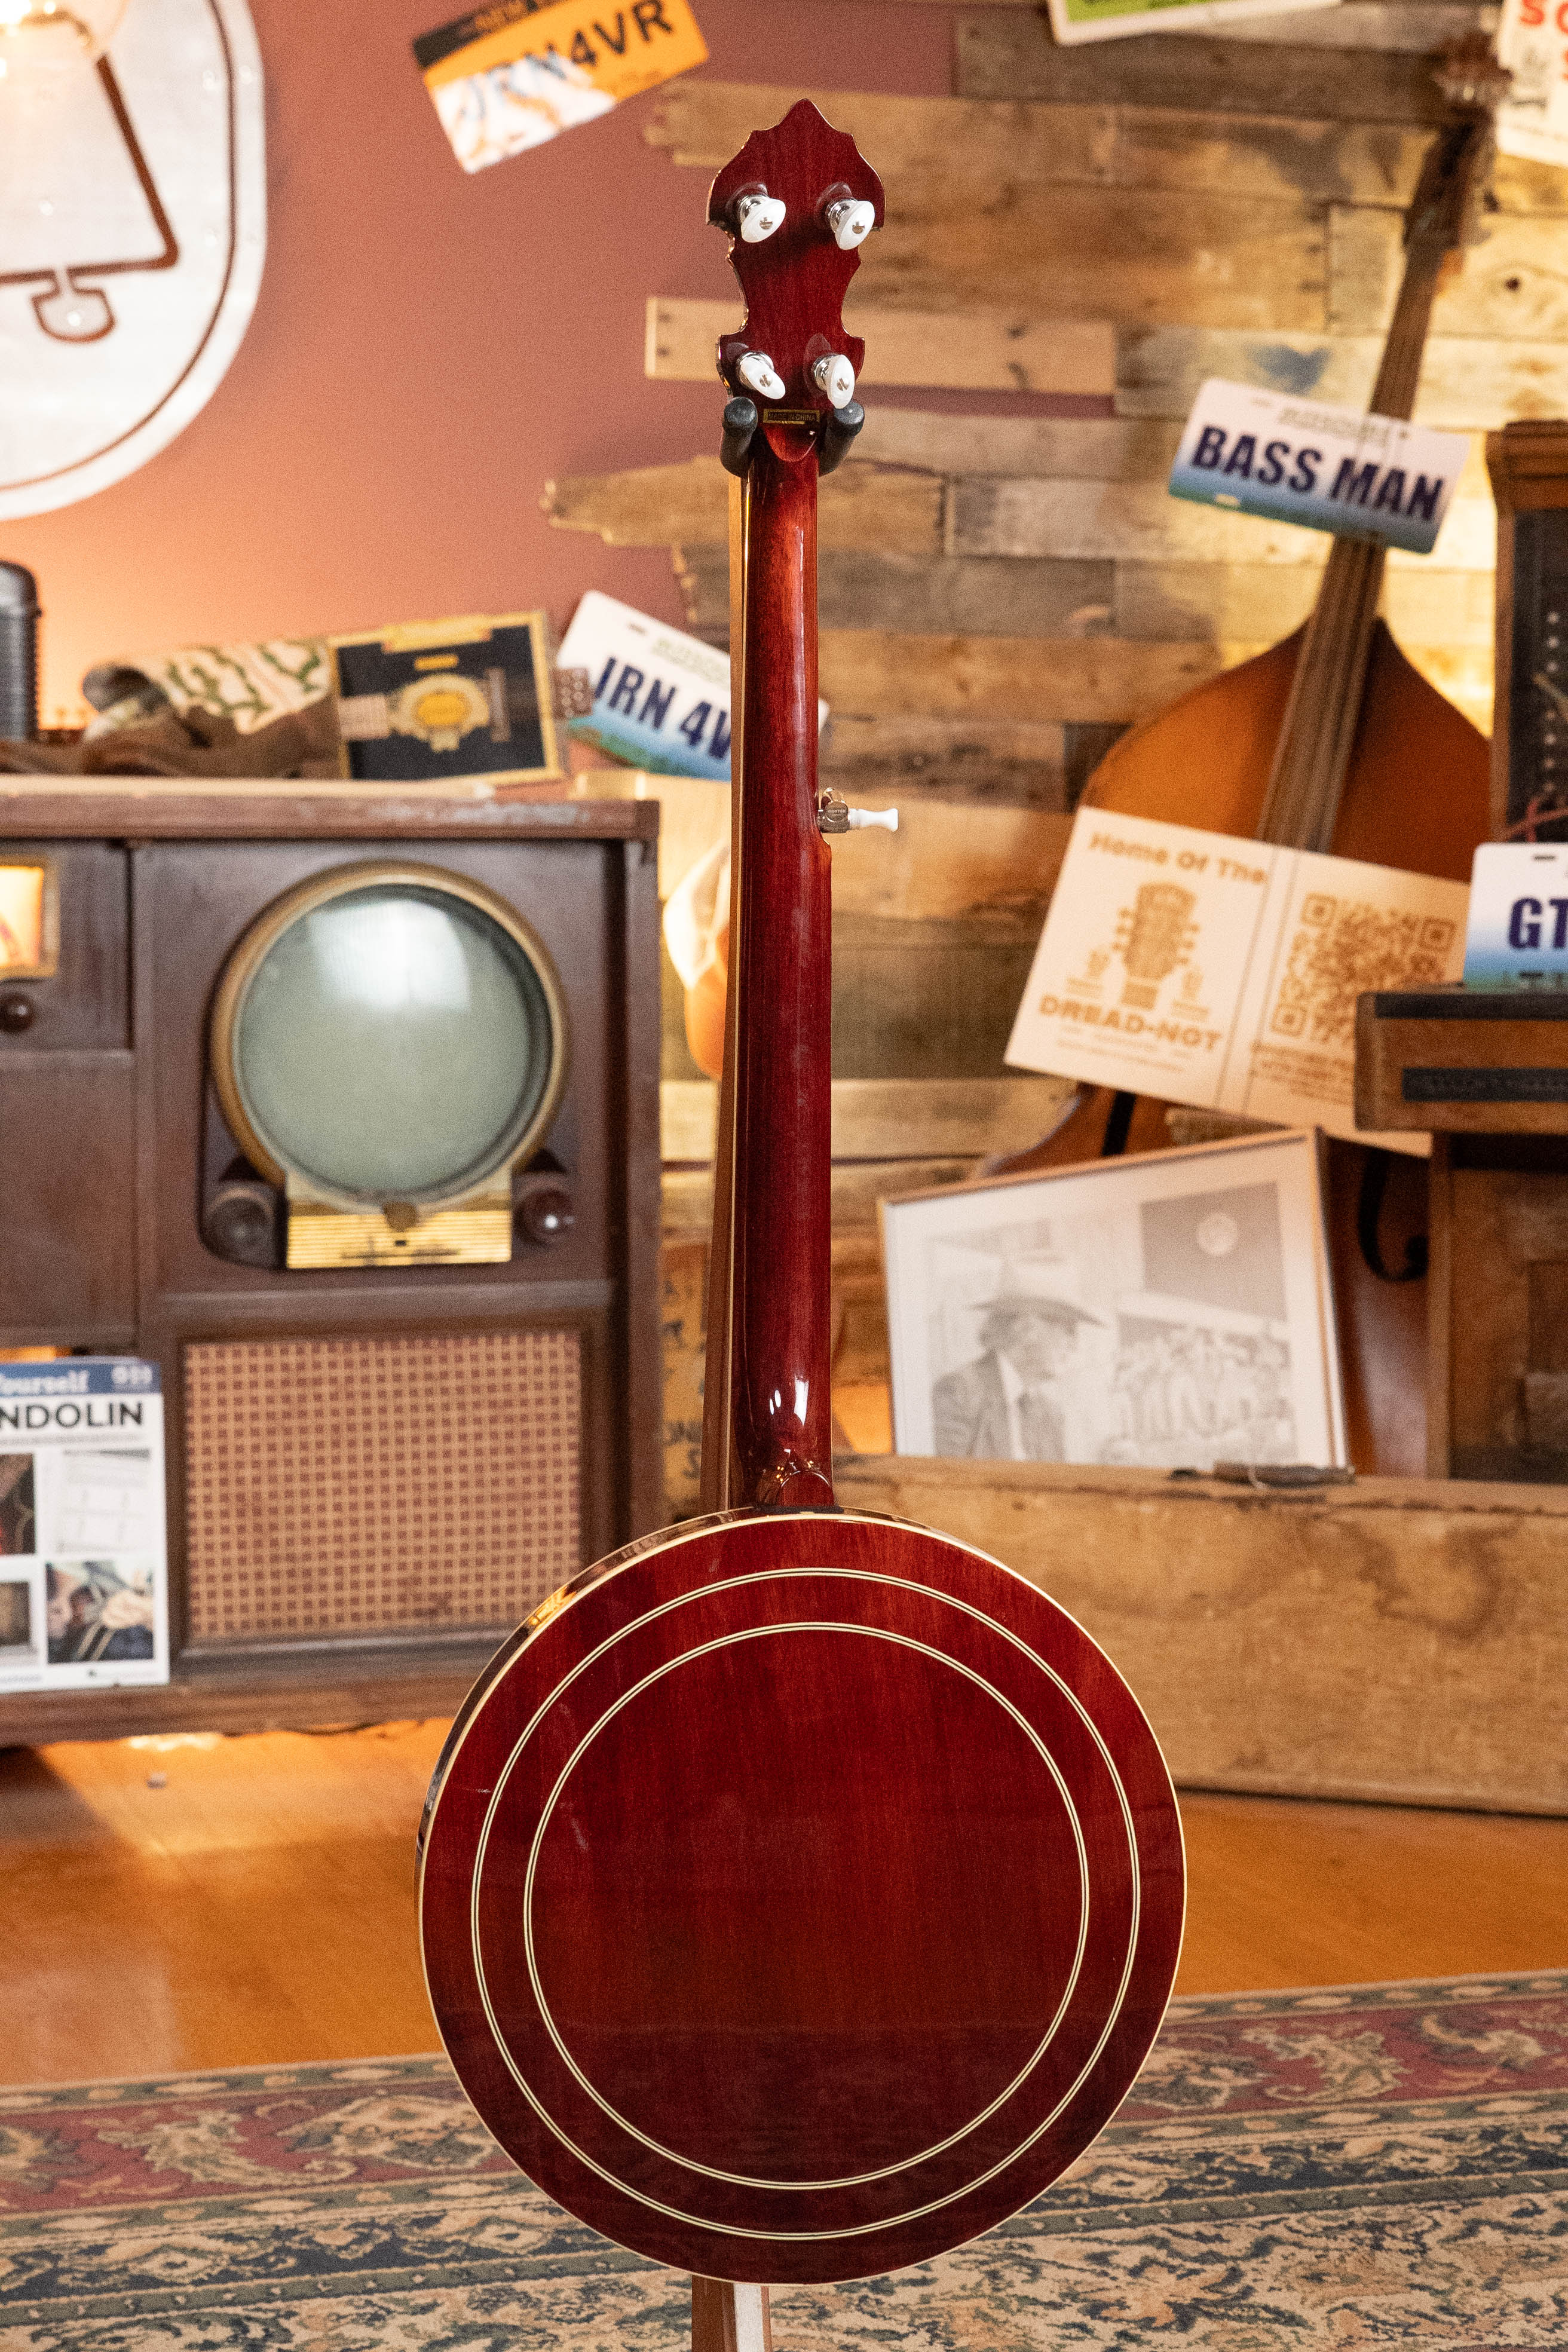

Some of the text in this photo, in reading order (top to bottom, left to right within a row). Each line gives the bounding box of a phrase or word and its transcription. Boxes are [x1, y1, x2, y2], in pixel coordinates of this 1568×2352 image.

[795, 413, 816, 421] CHINA
[1191, 423, 1322, 492] BASS
[1331, 457, 1443, 521] MAN
[1090, 832, 1268, 885] Home Of The
[1039, 993, 1222, 1052] DREAD-NOT
